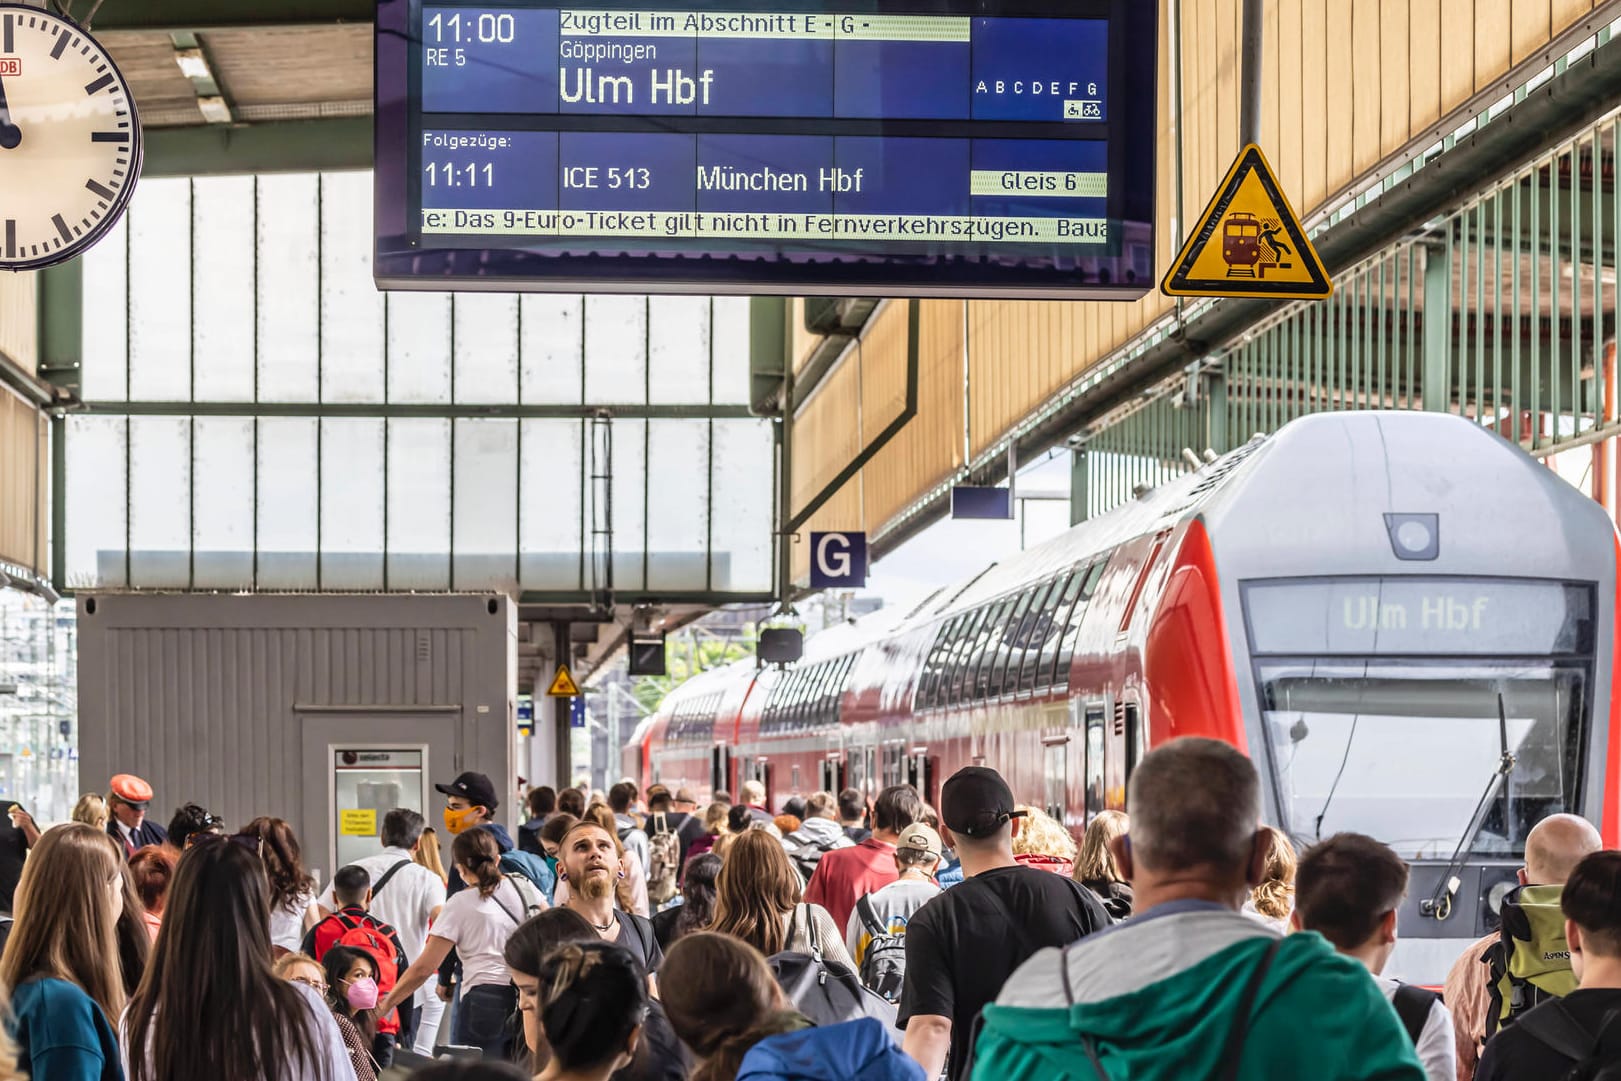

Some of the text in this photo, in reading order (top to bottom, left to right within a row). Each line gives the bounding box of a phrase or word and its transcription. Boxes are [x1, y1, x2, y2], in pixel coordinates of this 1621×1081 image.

[428, 13, 515, 43] 11:00
[560, 11, 641, 34] Zugteil
[650, 13, 675, 31] im
[684, 13, 796, 33] Abschnitt
[805, 15, 817, 33] E
[841, 16, 854, 34] G
[426, 48, 466, 66] RE 5
[560, 40, 657, 64] Göppingen
[0, 61, 17, 73] DB
[560, 68, 714, 105] Ulm Hbf
[976, 81, 1097, 95] A B C D E F G
[423, 133, 512, 150] Folgezüge:
[425, 162, 863, 192] 11:11 ICE 513 München Hbf
[1001, 173, 1076, 191] Gleis 6
[455, 210, 494, 229] Das
[503, 211, 656, 231] 9-Euro-Ticket
[665, 212, 702, 235] gilt
[713, 213, 769, 233] nicht
[778, 215, 797, 232] in
[805, 215, 1038, 240] Fernverkehrszügen.
[817, 533, 850, 578] G
[1343, 597, 1489, 630] Ulm Hbf
